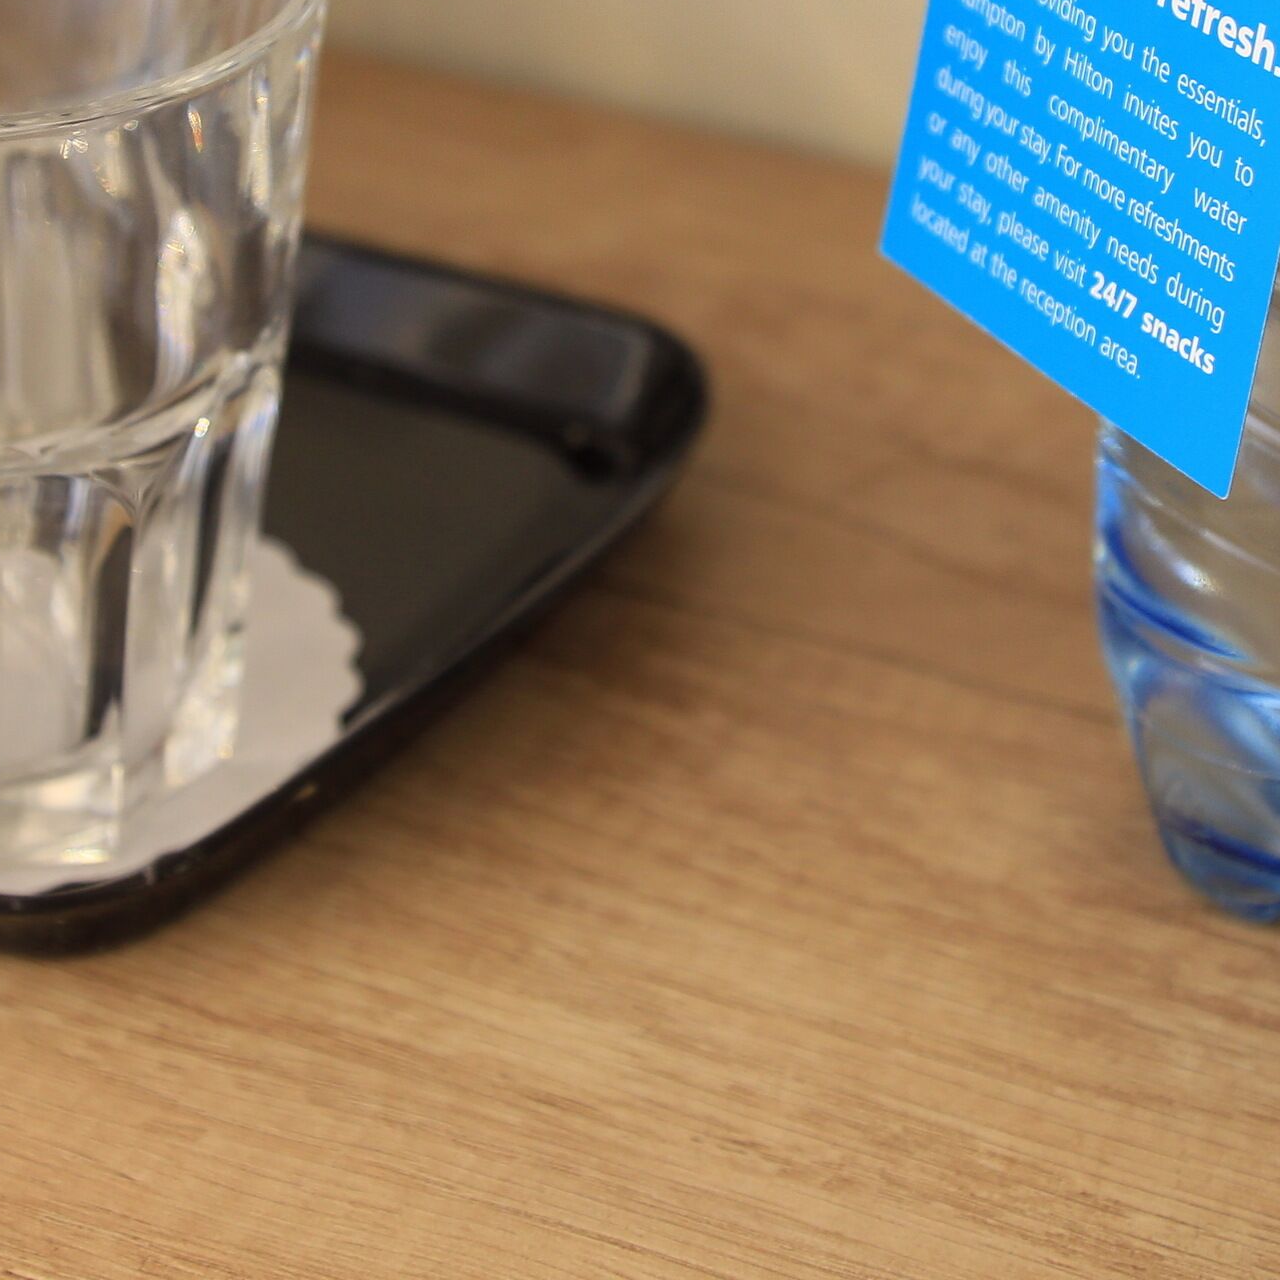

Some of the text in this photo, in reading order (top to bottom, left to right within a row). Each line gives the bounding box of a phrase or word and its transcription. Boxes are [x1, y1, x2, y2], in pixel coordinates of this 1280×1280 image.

[936, 66, 1236, 283] during your stay. For more refreshments
[943, 24, 1248, 235] enjoy this complimentary water
[1033, 25, 1057, 66] by
[1063, 47, 1114, 100] Hilton
[1123, 84, 1180, 141] invites
[1186, 131, 1224, 169] you
[1234, 156, 1255, 187] to
[1100, 25, 1135, 61] you
[1141, 46, 1171, 84] the
[1177, 73, 1266, 147] essentials,
[911, 194, 1141, 379] located at the reception area.
[918, 157, 1216, 375] your stay, please visit 24/7 snacks
[927, 112, 1226, 335] or any other amenity needs during
